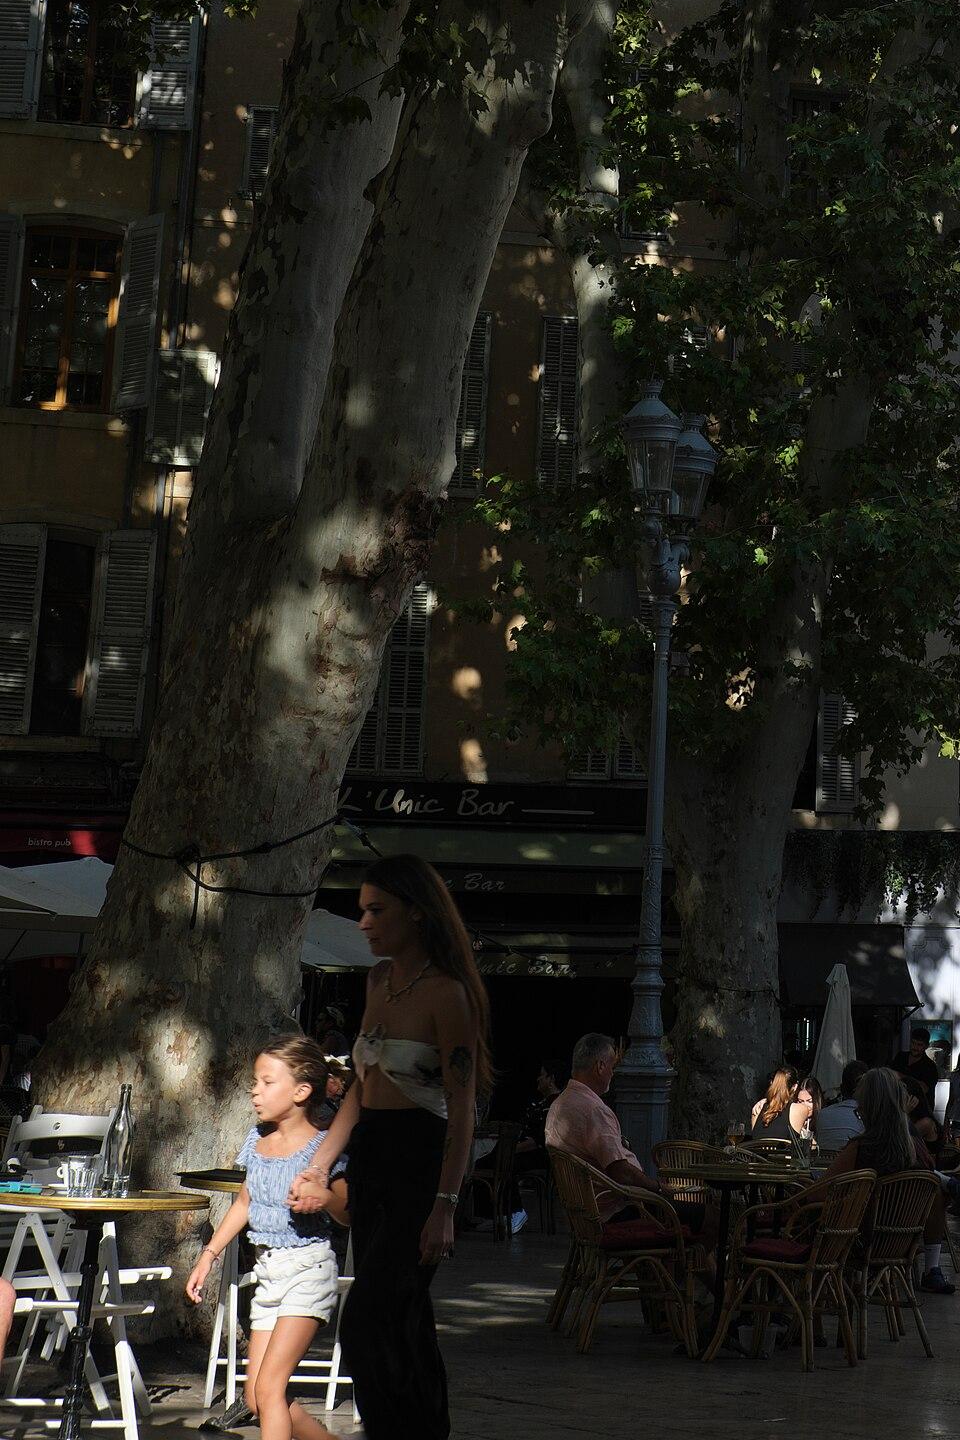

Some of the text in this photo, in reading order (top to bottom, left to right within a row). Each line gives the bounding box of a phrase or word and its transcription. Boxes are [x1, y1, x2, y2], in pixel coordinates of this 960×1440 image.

[456, 788, 516, 816] Bar
[27, 836, 71, 847] bistro pub
[463, 872, 505, 891] Bar
